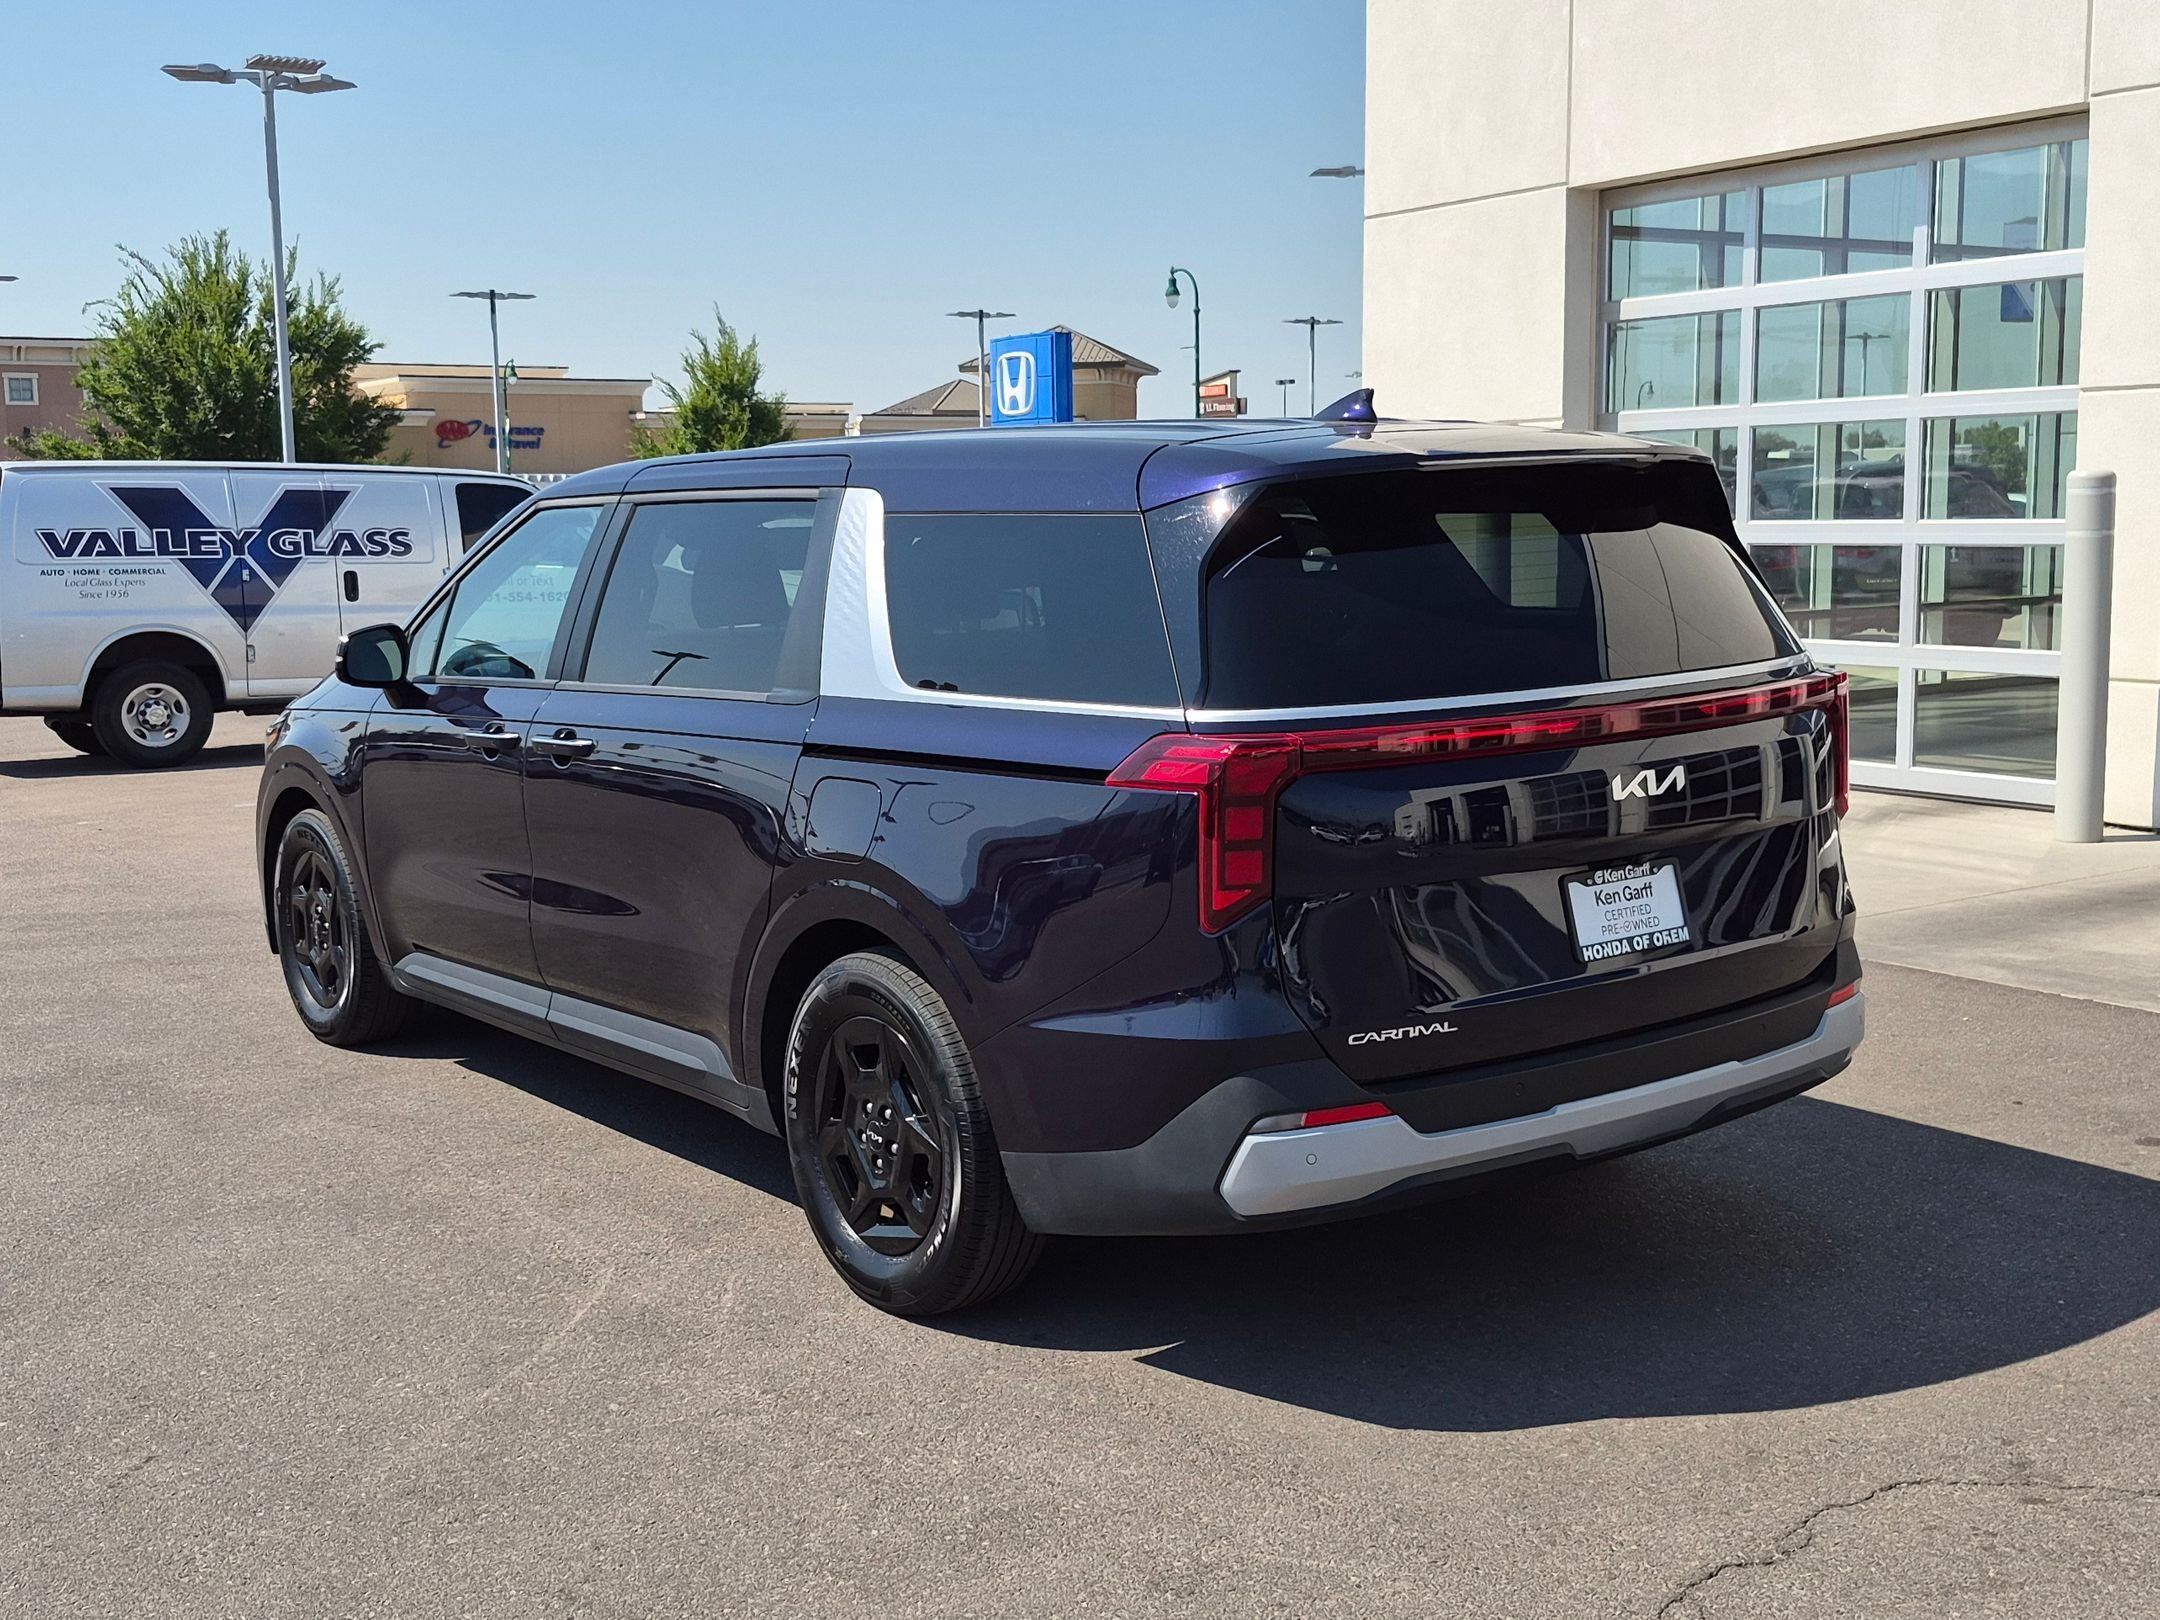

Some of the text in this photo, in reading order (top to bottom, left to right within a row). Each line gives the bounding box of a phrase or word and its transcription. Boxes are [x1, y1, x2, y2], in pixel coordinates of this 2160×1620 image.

[35, 527, 415, 559] VALLEY GLASS
[39, 567, 167, 577] AUTO HOME COMMERCIAL
[64, 577, 147, 588] Local Glass Experts
[78, 589, 130, 600] Since 1956
[1612, 765, 1686, 801] KIA
[1604, 861, 1651, 883] Ken Garff
[1594, 881, 1654, 908] Ken Garff
[1604, 903, 1652, 922] CERTIFIED
[1582, 939, 1632, 962] HONDA
[1632, 934, 1651, 952] OF
[1348, 1021, 1459, 1045] CARNIVAL
